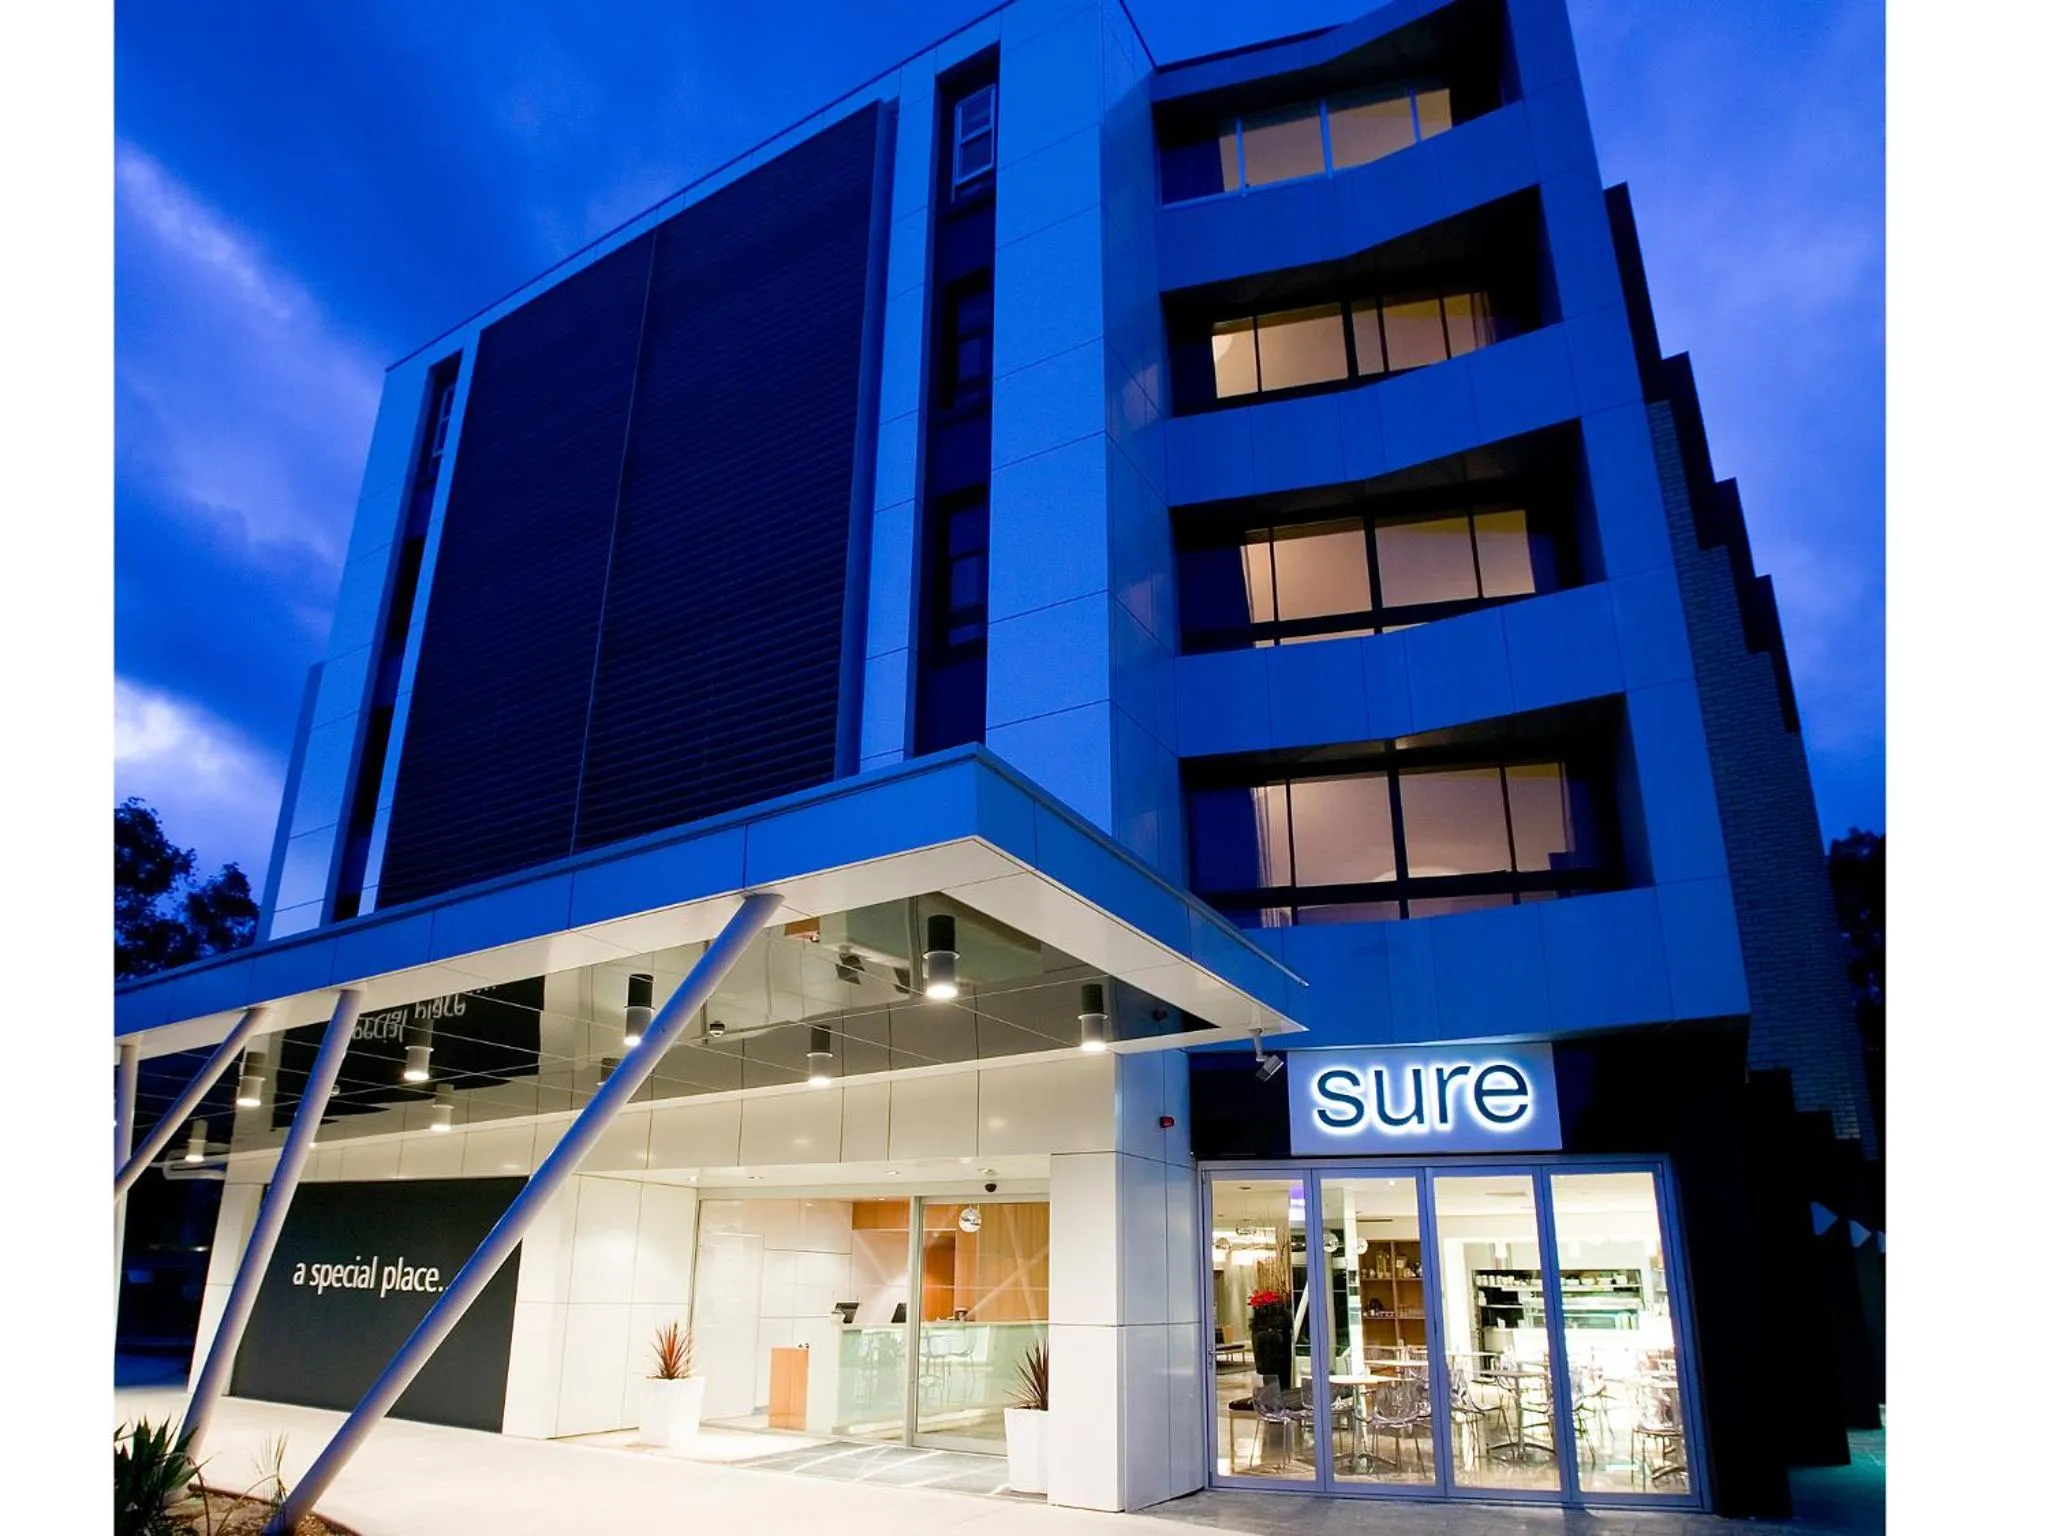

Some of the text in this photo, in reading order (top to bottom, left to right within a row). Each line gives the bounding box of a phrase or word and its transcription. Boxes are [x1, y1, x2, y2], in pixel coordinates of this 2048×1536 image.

[1316, 1063, 1529, 1129] sure
[293, 1262, 307, 1286] a
[309, 1255, 379, 1296] special
